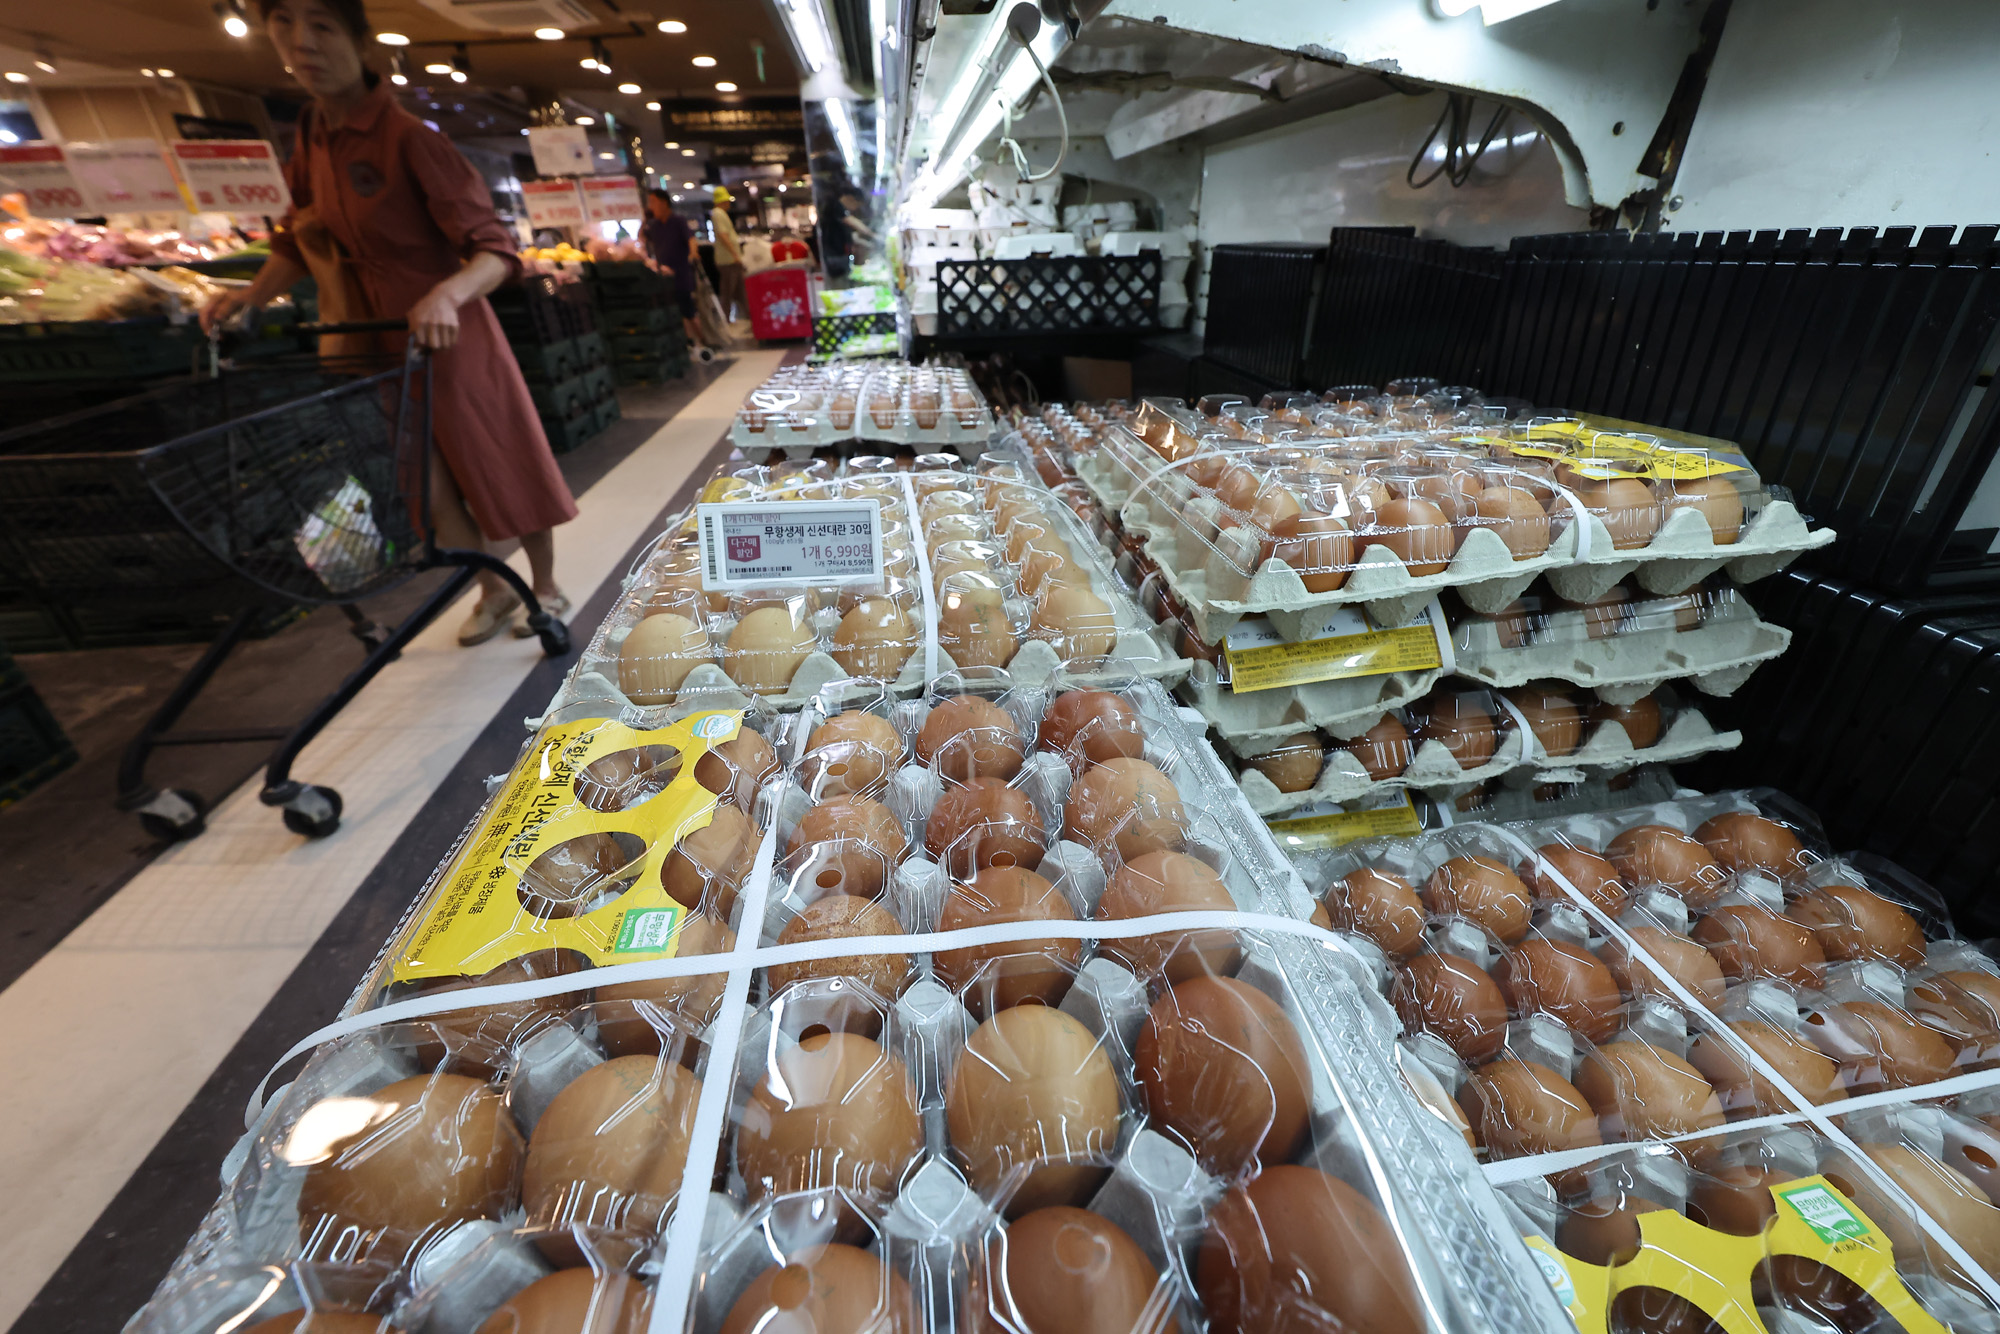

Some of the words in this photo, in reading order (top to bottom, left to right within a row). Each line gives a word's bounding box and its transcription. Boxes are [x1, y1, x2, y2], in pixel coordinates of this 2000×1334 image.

[764, 525, 804, 537] 무항생제
[807, 524, 847, 536] 신선대란
[850, 523, 872, 535] 30입
[731, 538, 757, 547] 다구매
[736, 548, 753, 557] 할인
[801, 545, 820, 559] 1개
[824, 543, 872, 559] 6,990원
[500, 792, 560, 859] 신선대란
[468, 881, 498, 915] 냉장제품
[1796, 1194, 1837, 1212] 무항생제
